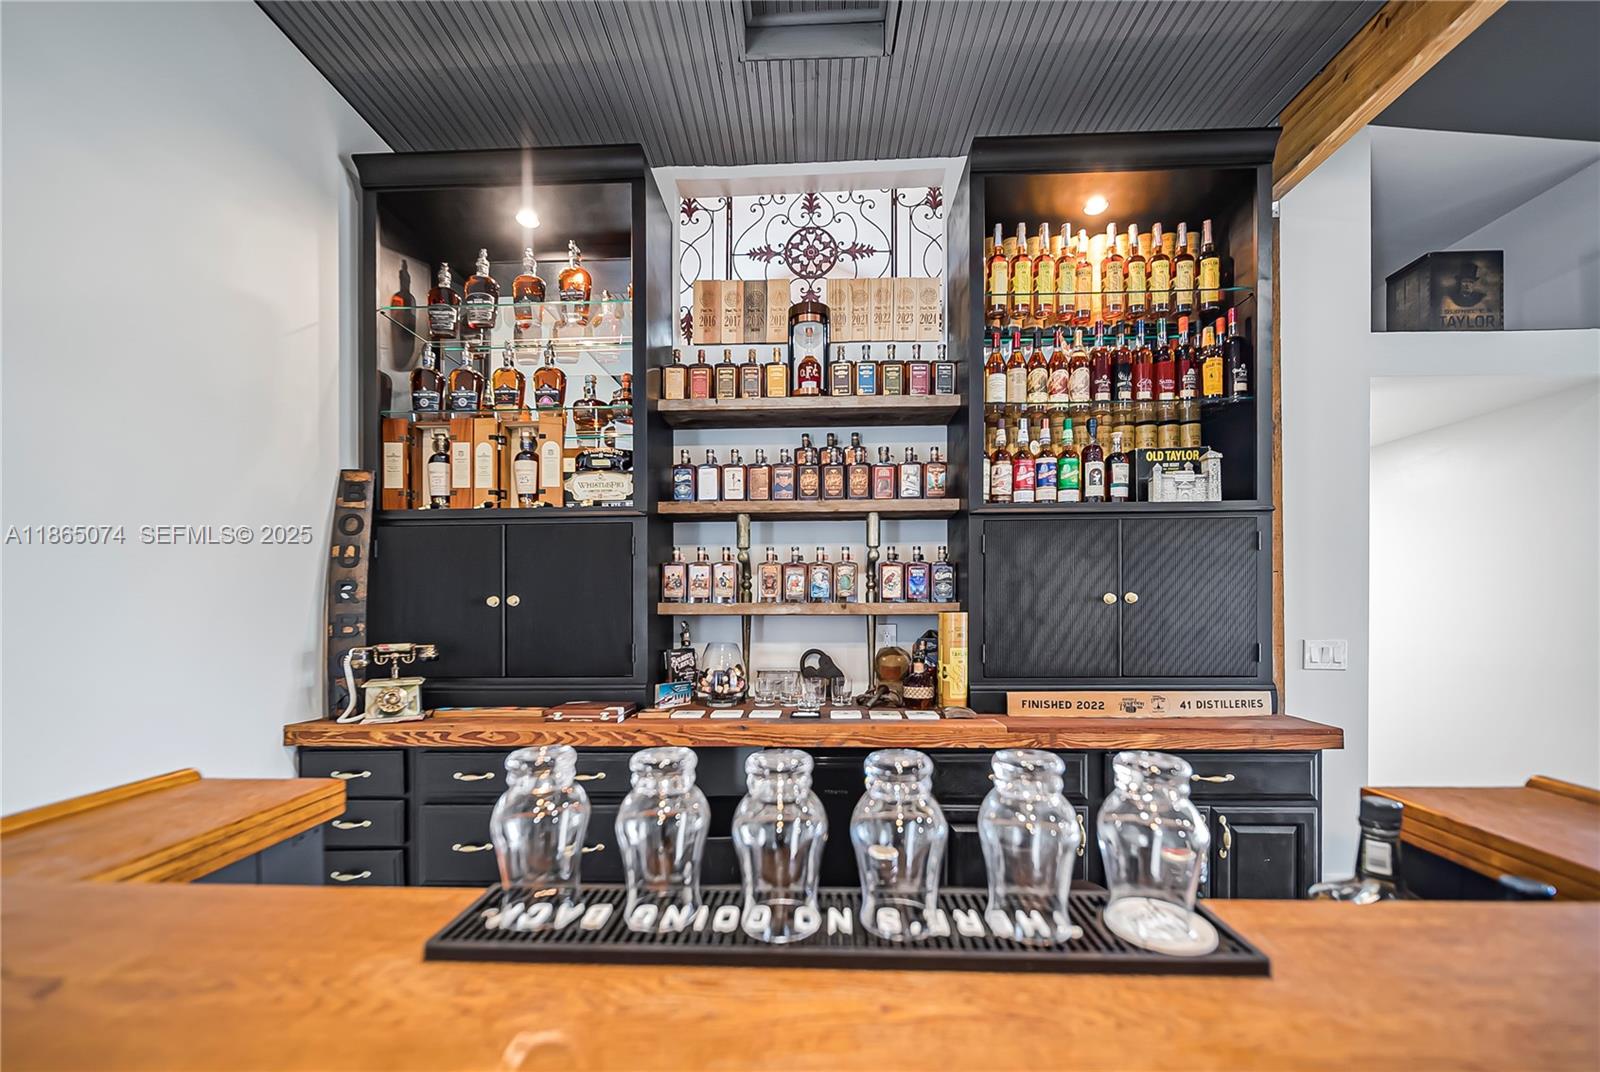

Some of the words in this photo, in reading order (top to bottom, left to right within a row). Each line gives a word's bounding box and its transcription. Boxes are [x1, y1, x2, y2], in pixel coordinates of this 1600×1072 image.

[699, 315, 716, 327] 2016
[724, 315, 741, 327] 2017
[769, 315, 787, 327] 2019
[851, 313, 869, 325] 2021
[873, 312, 891, 324] 2022
[896, 312, 914, 324] 2023
[919, 312, 937, 324] 2024
[1440, 315, 1495, 328] TAYLOR
[1146, 451, 1164, 462] OLD
[1165, 450, 1200, 462] TAYLOR
[1021, 700, 1072, 710] FINISHED
[1076, 701, 1105, 710] 2022
[1179, 701, 1192, 710] 41
[1196, 699, 1264, 710] DISTILLERIES
[628, 903, 773, 935] GOING
[793, 906, 855, 938] NO
